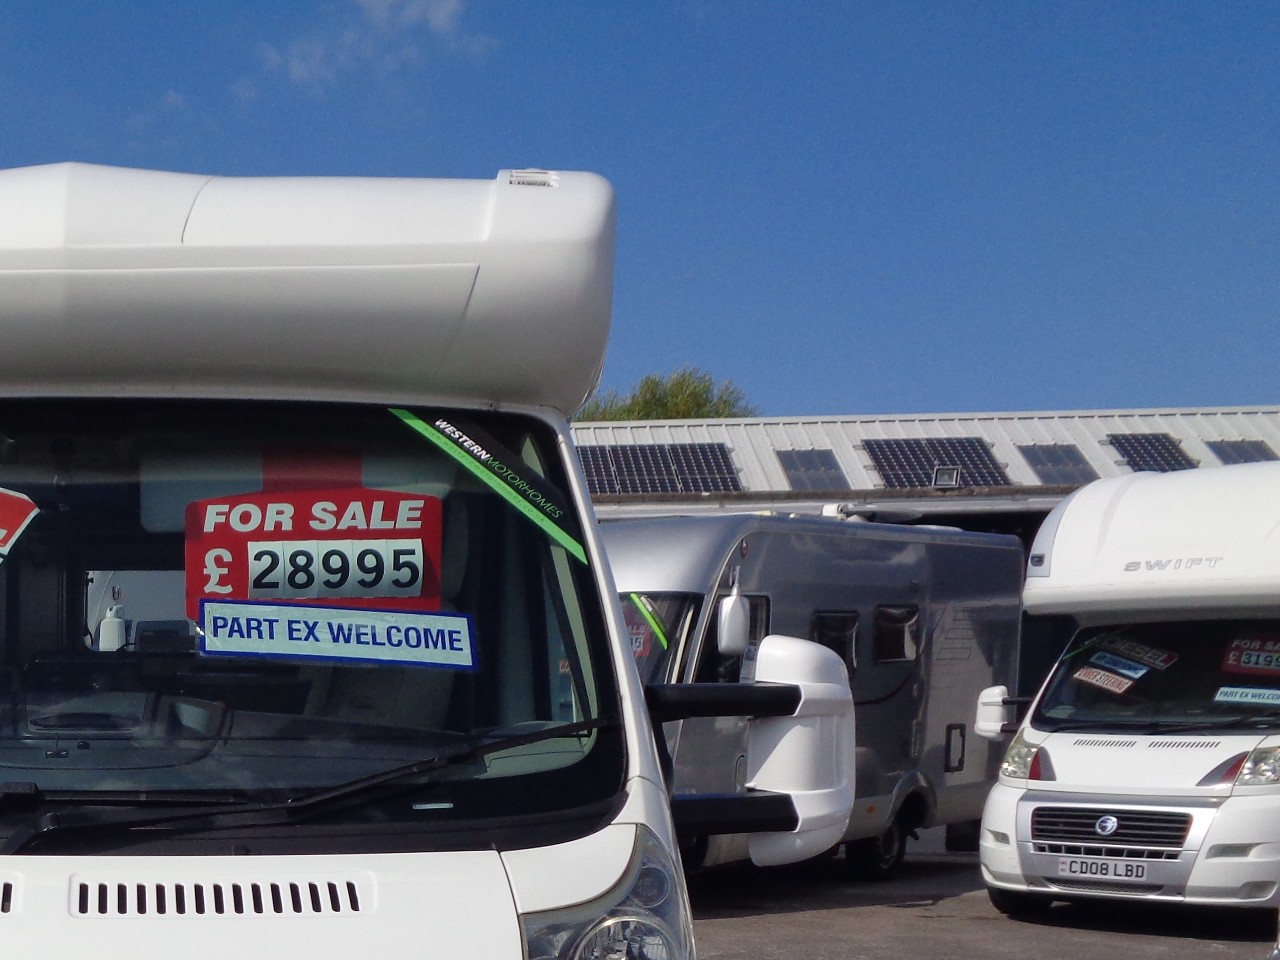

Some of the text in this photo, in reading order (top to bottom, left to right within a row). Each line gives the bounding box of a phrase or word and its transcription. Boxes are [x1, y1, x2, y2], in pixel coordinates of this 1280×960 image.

[434, 418, 564, 519] WESTERNMOTORHOMES
[202, 500, 425, 533] FOR SALE
[203, 547, 420, 594] £ 28995
[1123, 556, 1224, 572] SWIFT
[211, 616, 464, 652] PART EX WELCOME
[1232, 639, 1261, 650] FOR
[1069, 860, 1109, 876] CD08
[1113, 863, 1145, 878] LBD
